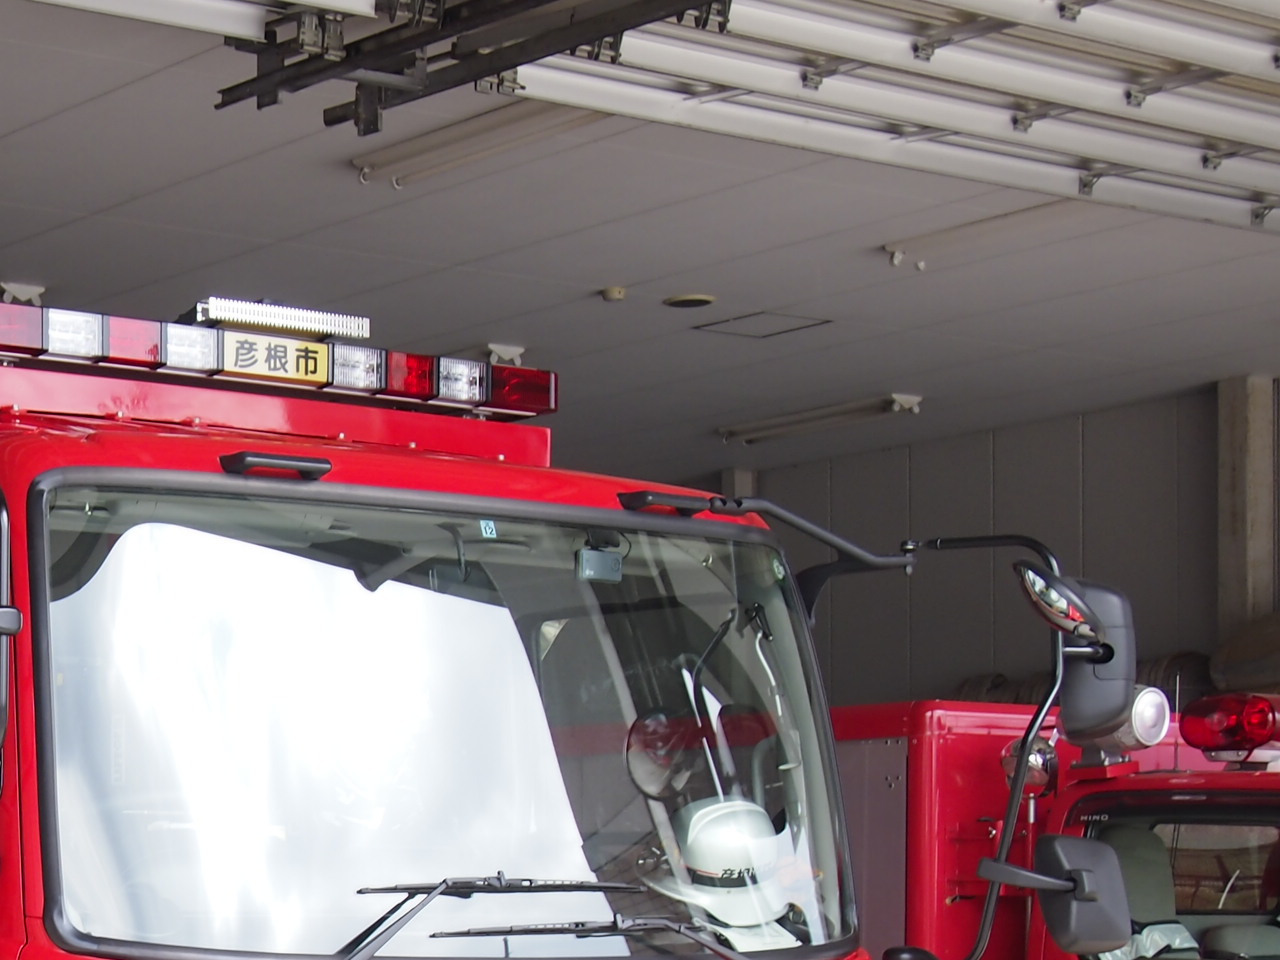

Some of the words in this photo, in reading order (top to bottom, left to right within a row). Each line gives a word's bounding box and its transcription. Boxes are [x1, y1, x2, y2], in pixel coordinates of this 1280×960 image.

[233, 338, 320, 379] 彦根市
[1080, 813, 1109, 822] HINO
